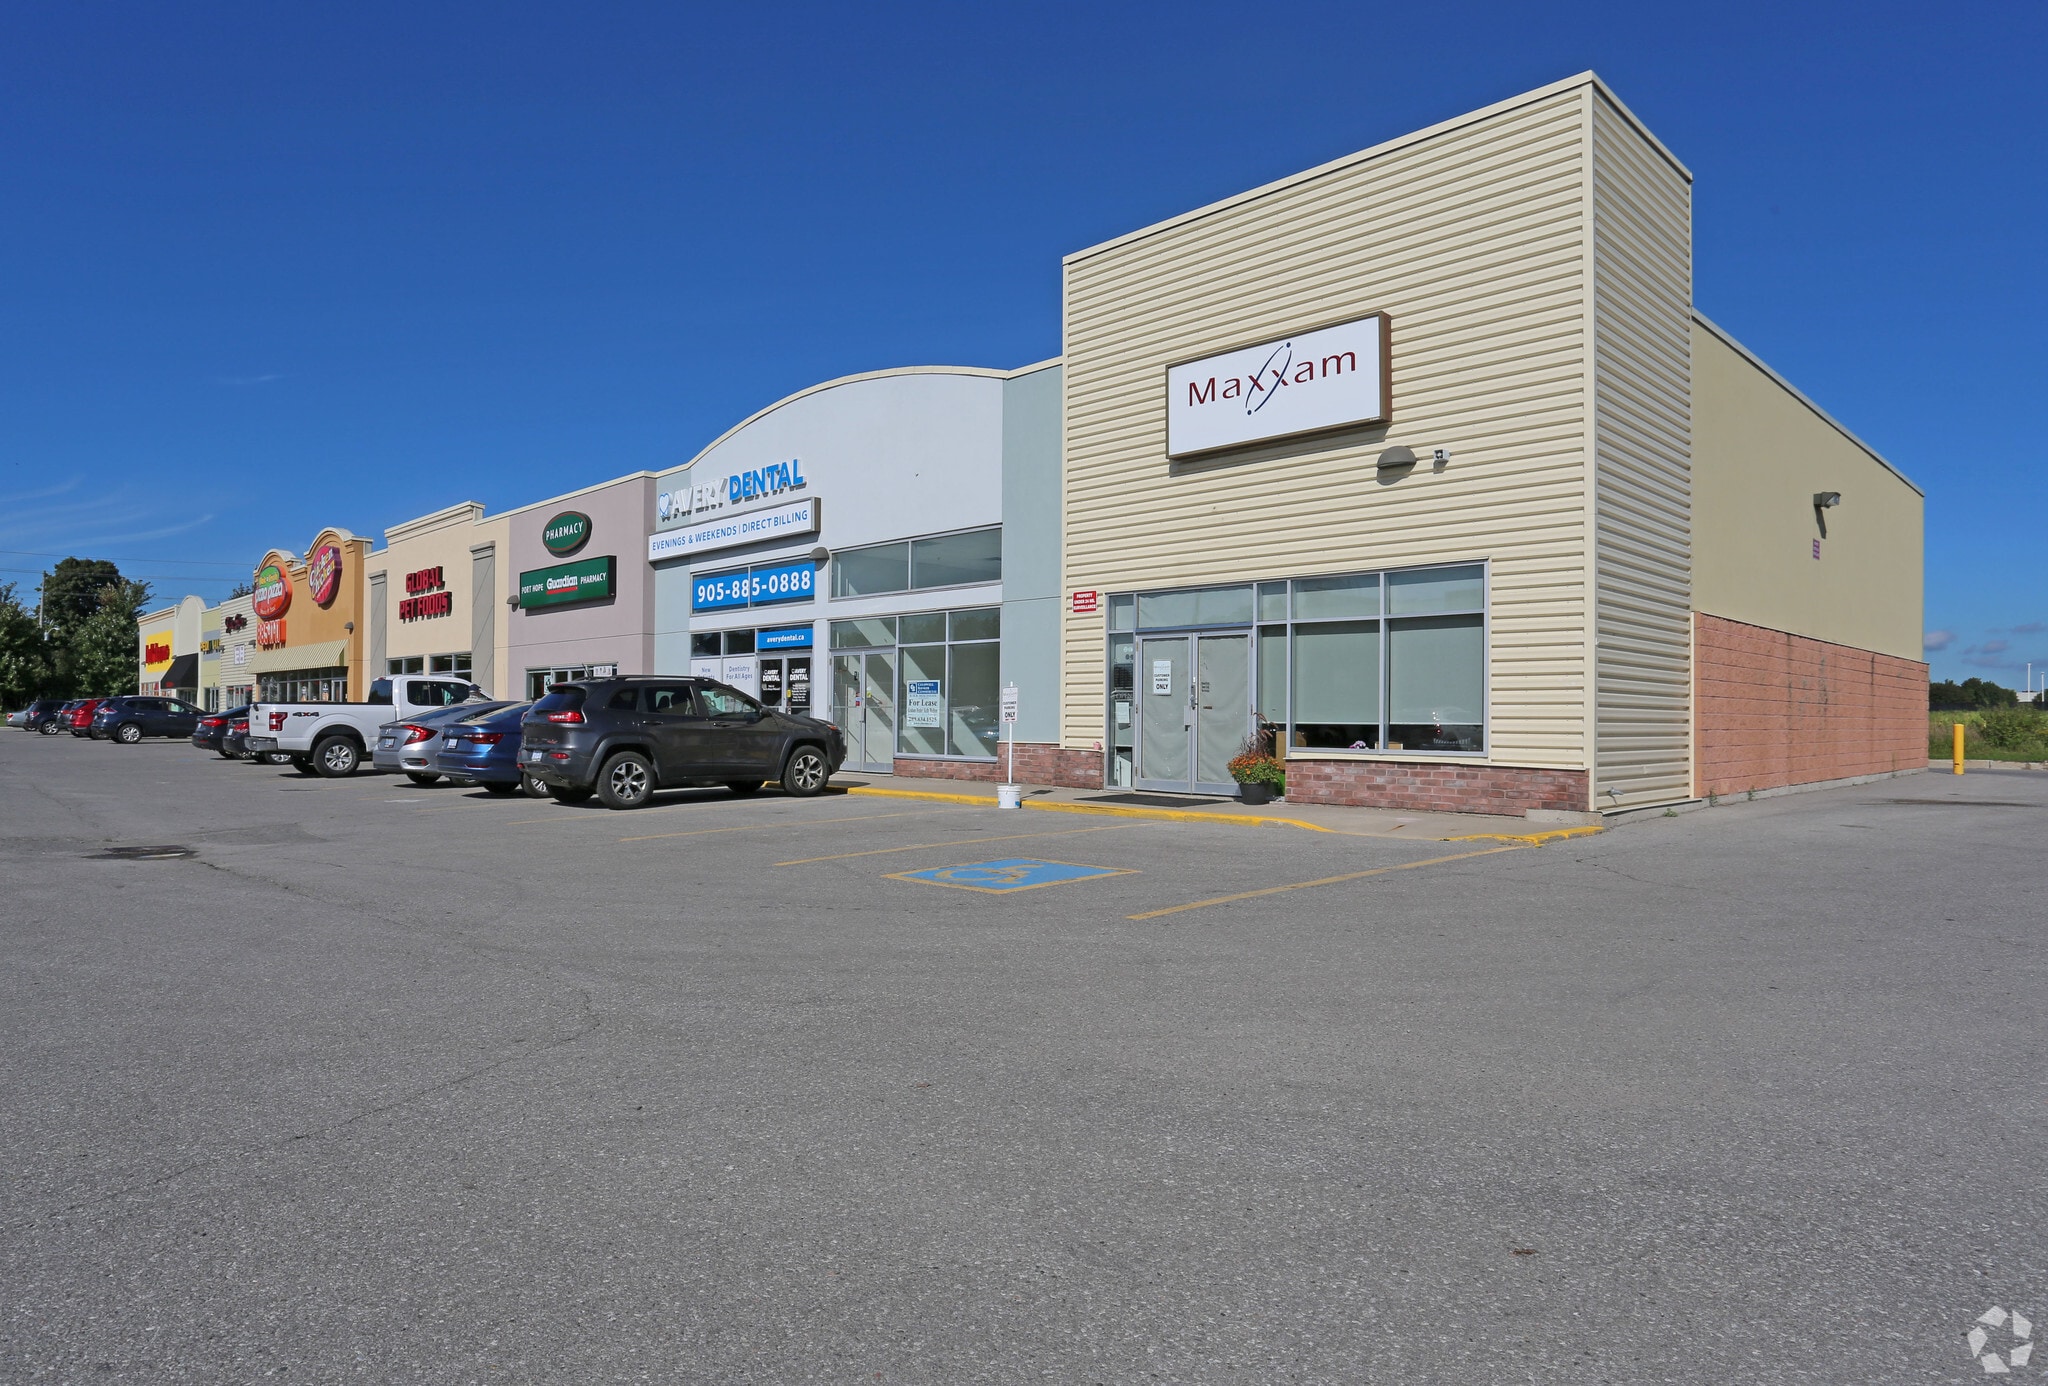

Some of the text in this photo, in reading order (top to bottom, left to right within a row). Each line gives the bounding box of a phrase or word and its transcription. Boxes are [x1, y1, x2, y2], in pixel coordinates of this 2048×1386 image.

[1188, 351, 1356, 407] Maxxam
[670, 459, 804, 515] AVERY DENTAL
[545, 521, 584, 541] PHARMACY
[652, 509, 808, 551] EVENINGS & WEEKENDS DIRECT BILLING
[406, 566, 443, 594] GLOBAL
[521, 571, 608, 594] PORT HOPE Guardian PHARMACY
[697, 570, 811, 603] 905-885-0888
[400, 593, 449, 620] PET FOODS
[766, 634, 805, 644] averydental.ca
[729, 665, 750, 673] Dentistry
